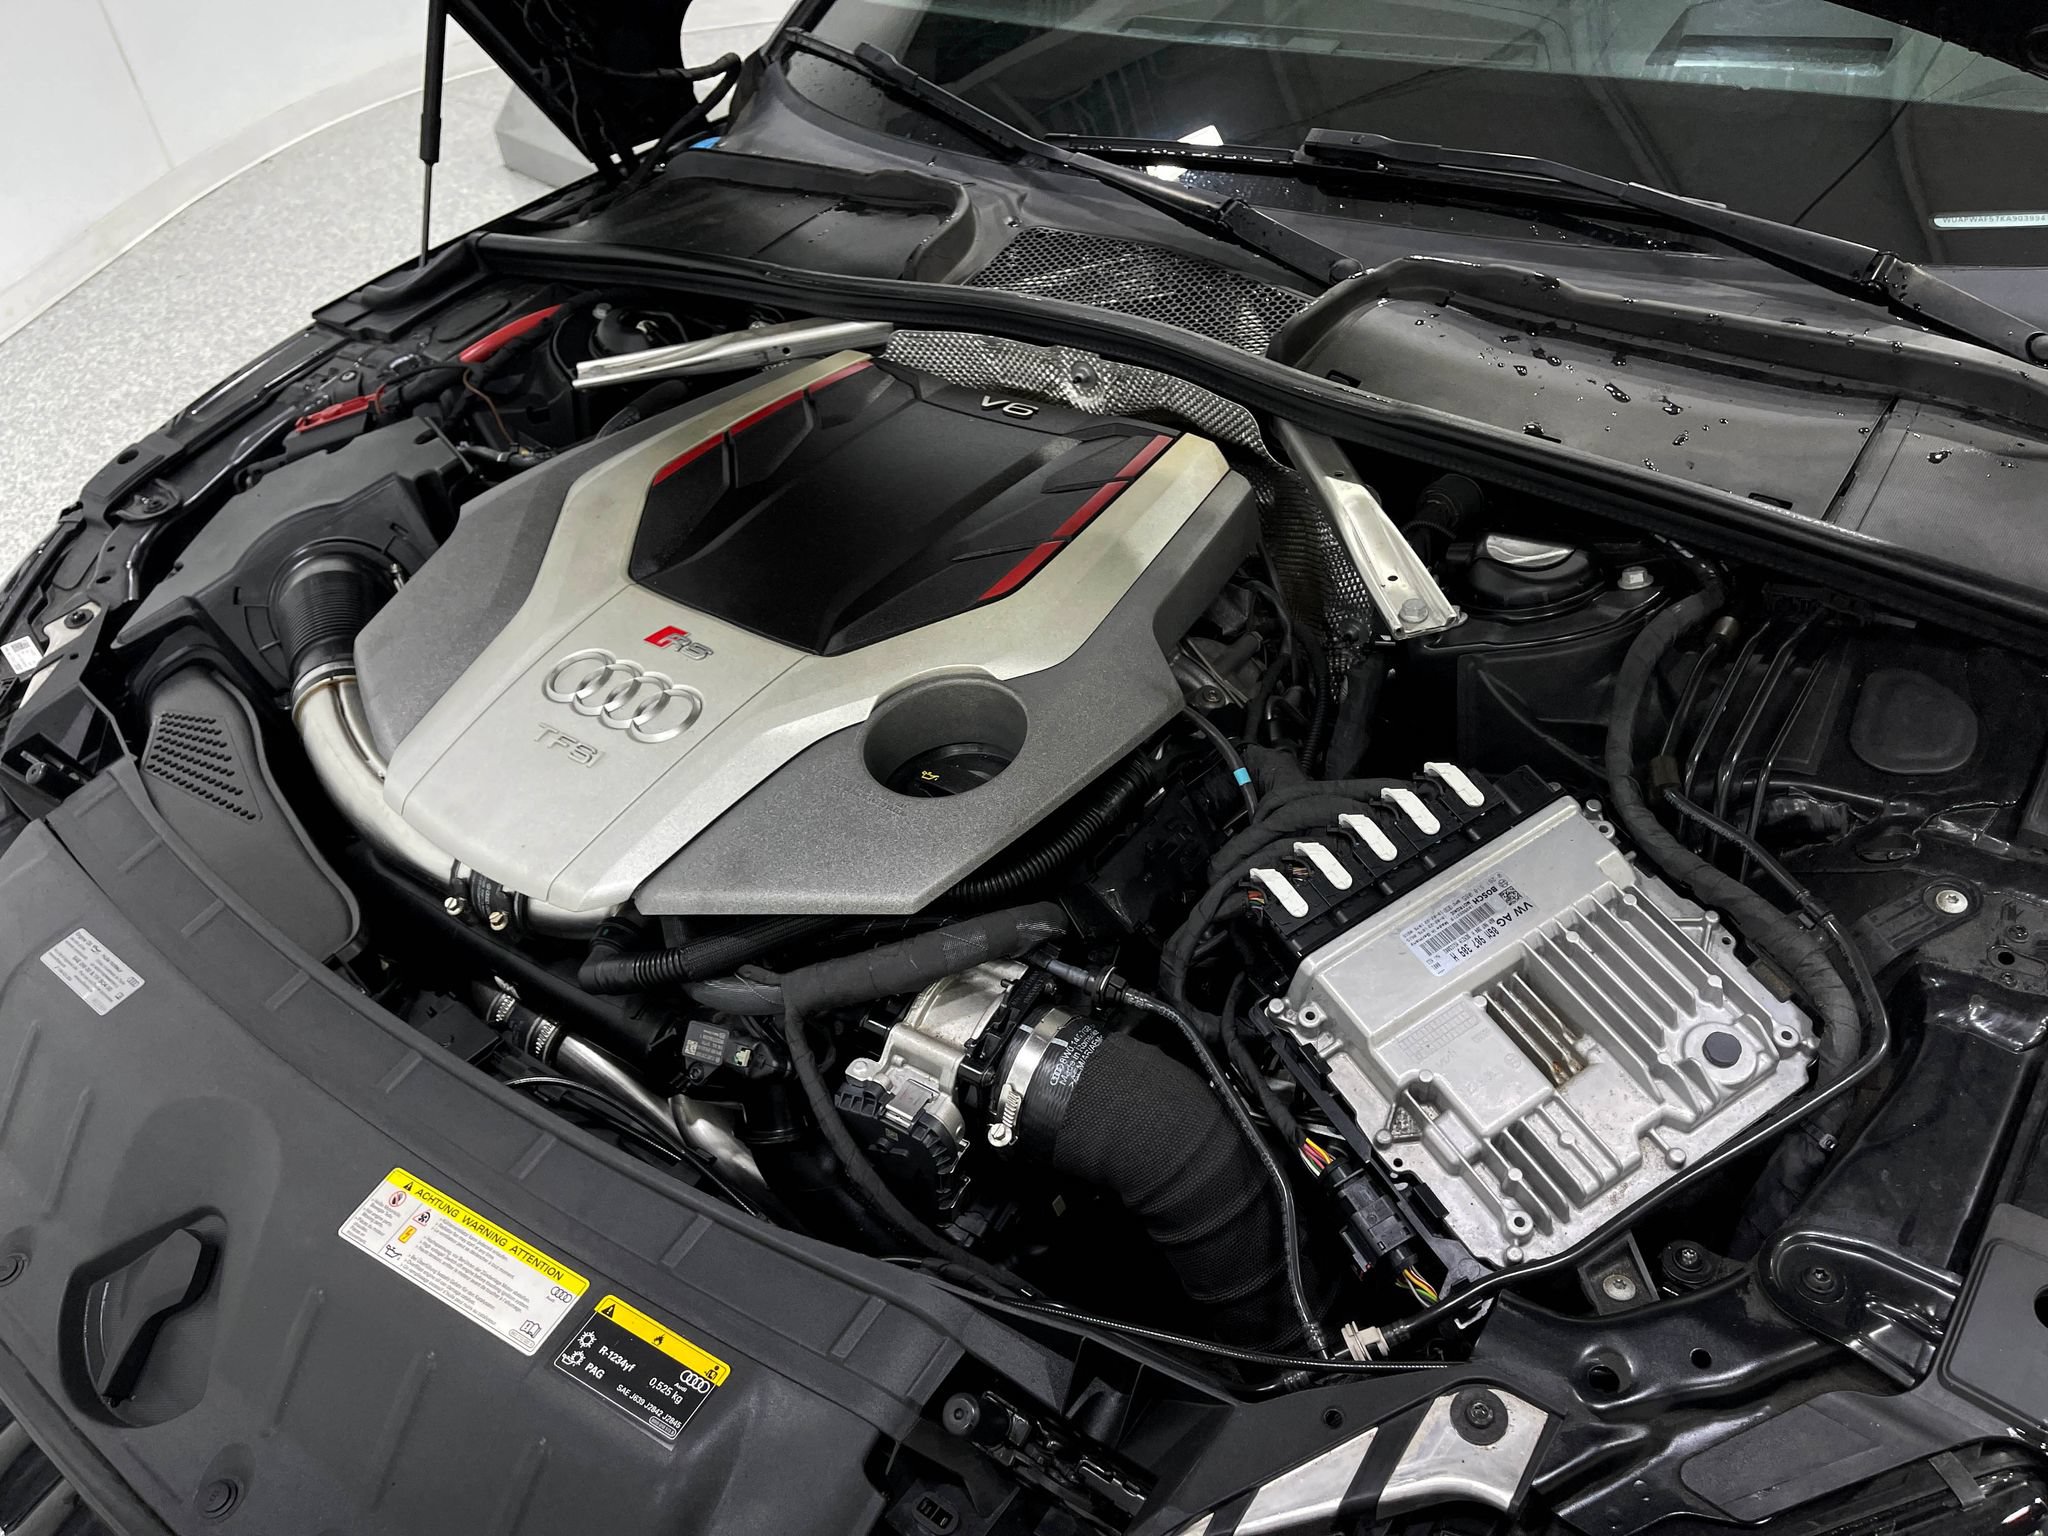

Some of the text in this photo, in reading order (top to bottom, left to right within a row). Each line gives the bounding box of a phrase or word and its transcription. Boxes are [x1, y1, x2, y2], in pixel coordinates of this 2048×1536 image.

[981, 395, 1039, 416] V6
[533, 722, 606, 769] TFSI
[1472, 886, 1498, 905] BOSCH
[1496, 901, 1534, 927] VW AG
[414, 1187, 460, 1218] ACHTUNG
[460, 1214, 509, 1247] WARNING
[508, 1243, 564, 1280] ATTENTION
[583, 1362, 605, 1379] PAG
[596, 1345, 636, 1374] R-1234yf
[647, 1376, 685, 1404] 0,525 kg
[673, 1381, 688, 1392] Audi
[615, 1383, 631, 1396] SAE
[628, 1391, 646, 1405] J639
[643, 1401, 663, 1416] J2842
[661, 1412, 682, 1428] J2845
